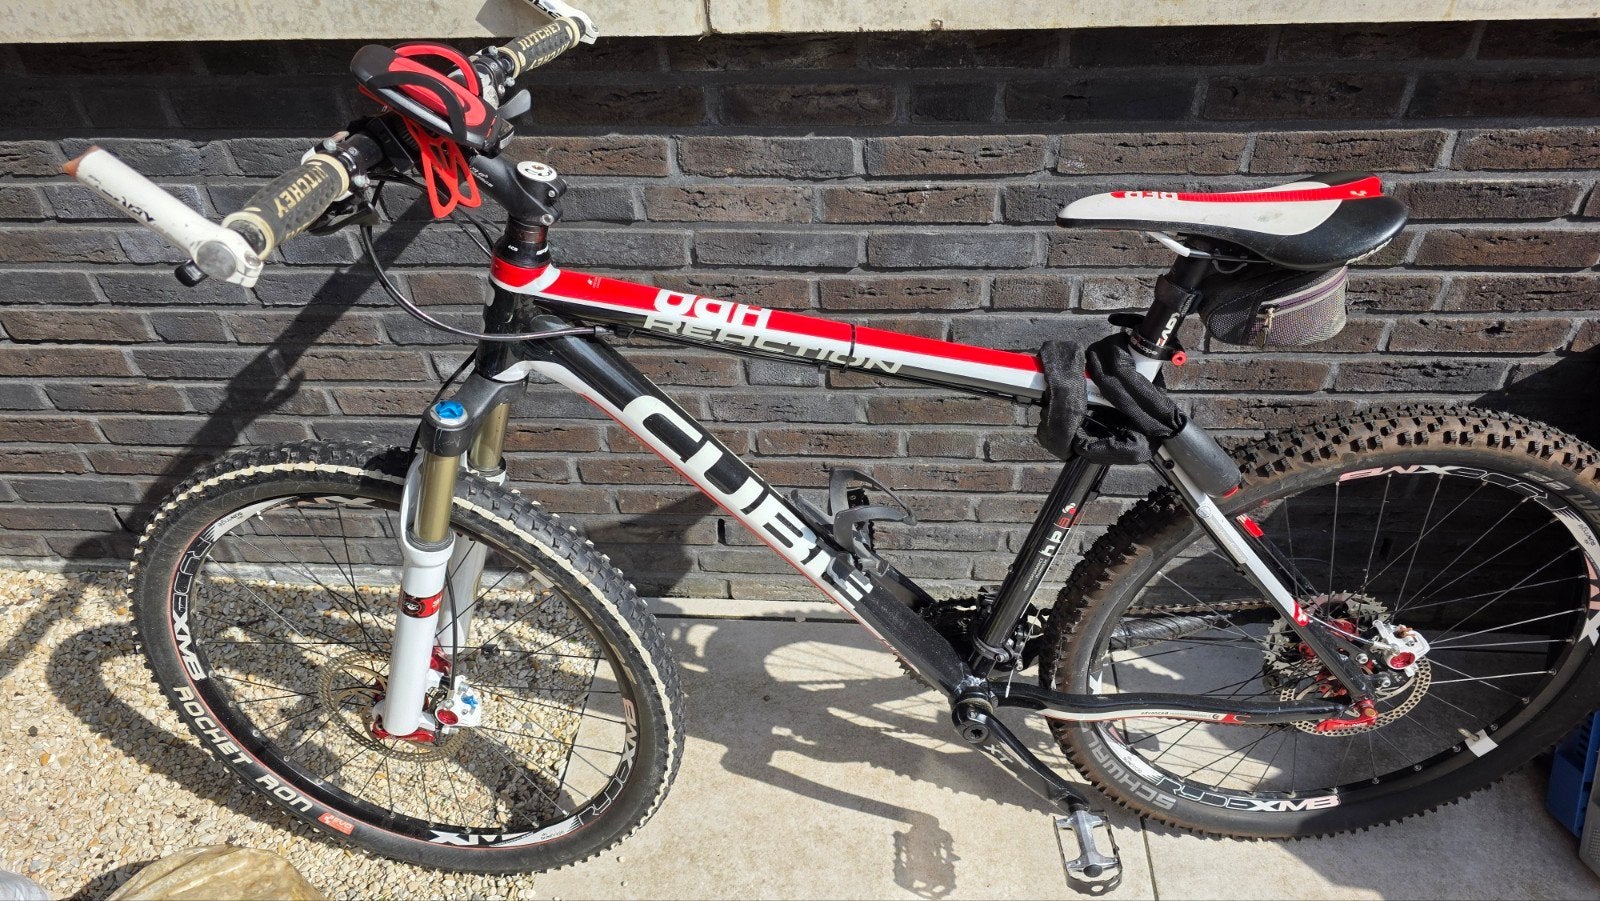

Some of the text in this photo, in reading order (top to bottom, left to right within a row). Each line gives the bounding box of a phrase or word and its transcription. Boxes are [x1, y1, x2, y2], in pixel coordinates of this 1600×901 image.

[517, 22, 561, 51] RITCHEY
[643, 316, 904, 374] REACTION
[1081, 722, 1177, 810] SCHWAL
[255, 774, 314, 813] RON
